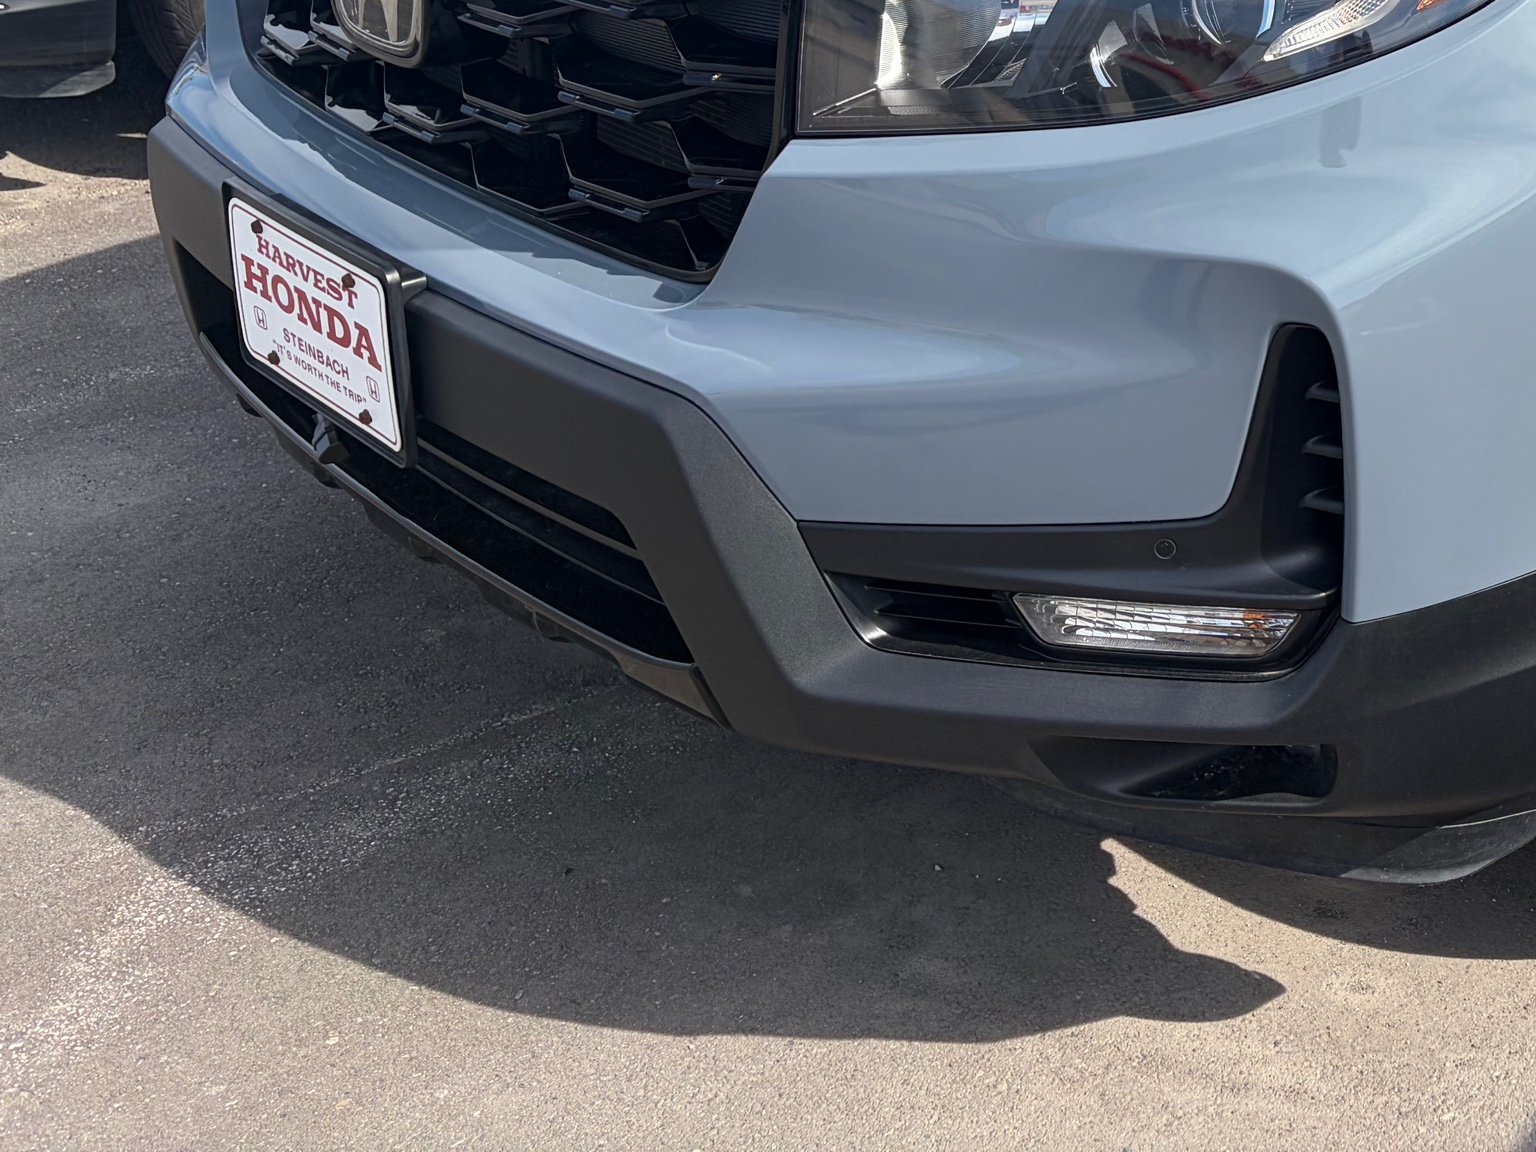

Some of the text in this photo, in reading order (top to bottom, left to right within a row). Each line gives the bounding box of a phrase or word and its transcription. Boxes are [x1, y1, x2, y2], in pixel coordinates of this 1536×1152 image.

[256, 234, 358, 309] HARVEST
[241, 253, 382, 373] HONDA
[283, 327, 349, 381] STEINBACH
[294, 354, 324, 381] WORTH
[325, 374, 342, 393] THE
